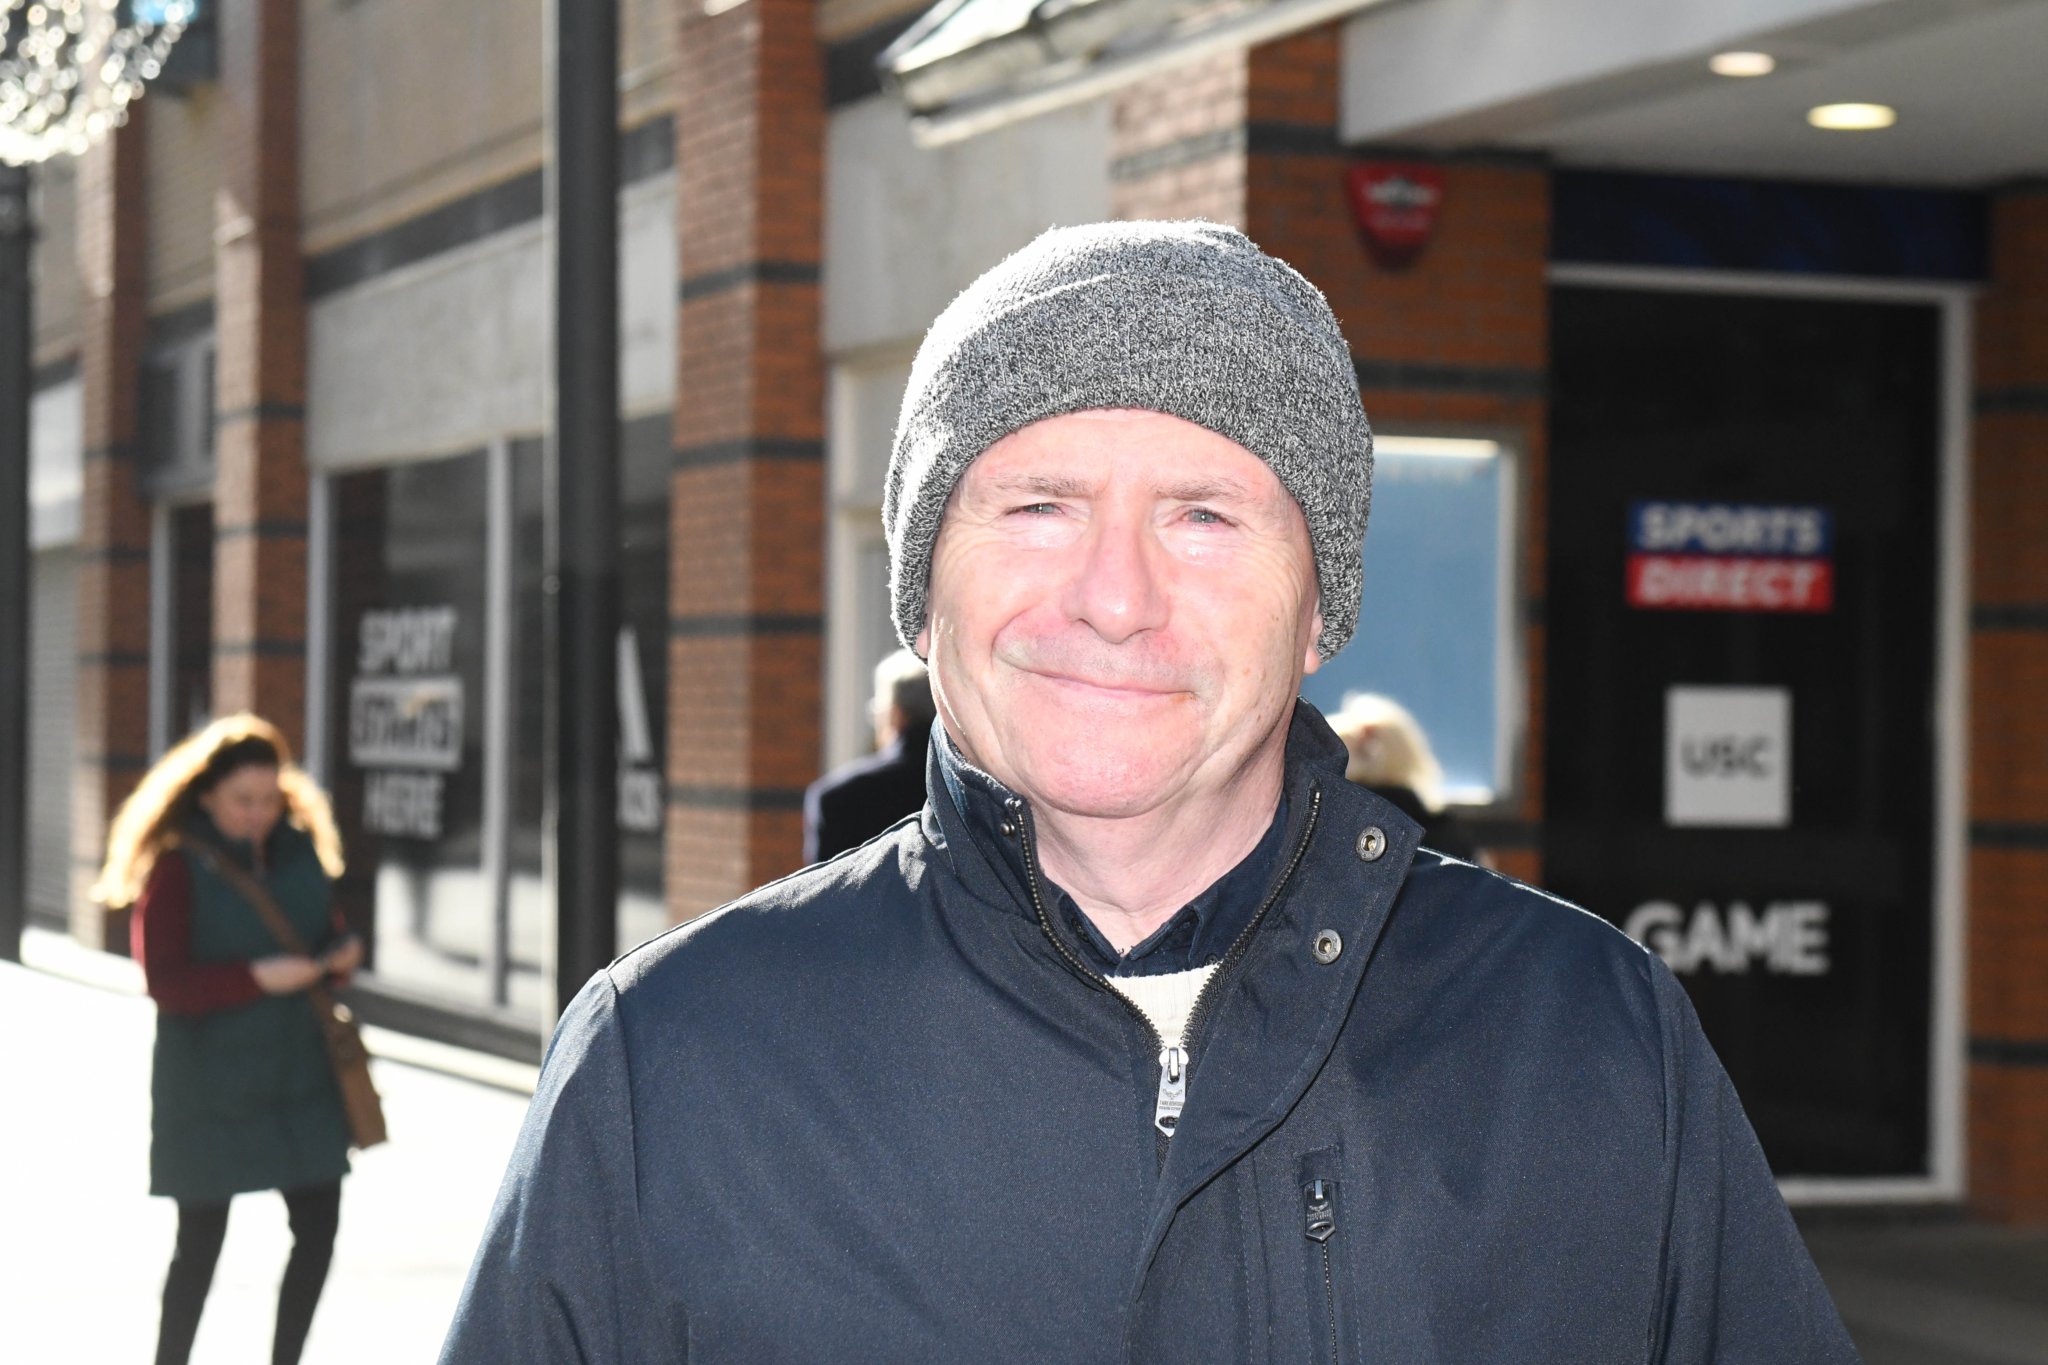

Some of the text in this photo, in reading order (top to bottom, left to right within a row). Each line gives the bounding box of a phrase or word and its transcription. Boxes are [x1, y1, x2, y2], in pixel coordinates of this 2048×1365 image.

[1641, 503, 1823, 552] SPORTS
[1638, 556, 1816, 606] DIRECT
[361, 606, 456, 672] SPORT
[1681, 737, 1774, 778] USC
[365, 771, 442, 837] HERE
[1626, 903, 1829, 974] GAME
